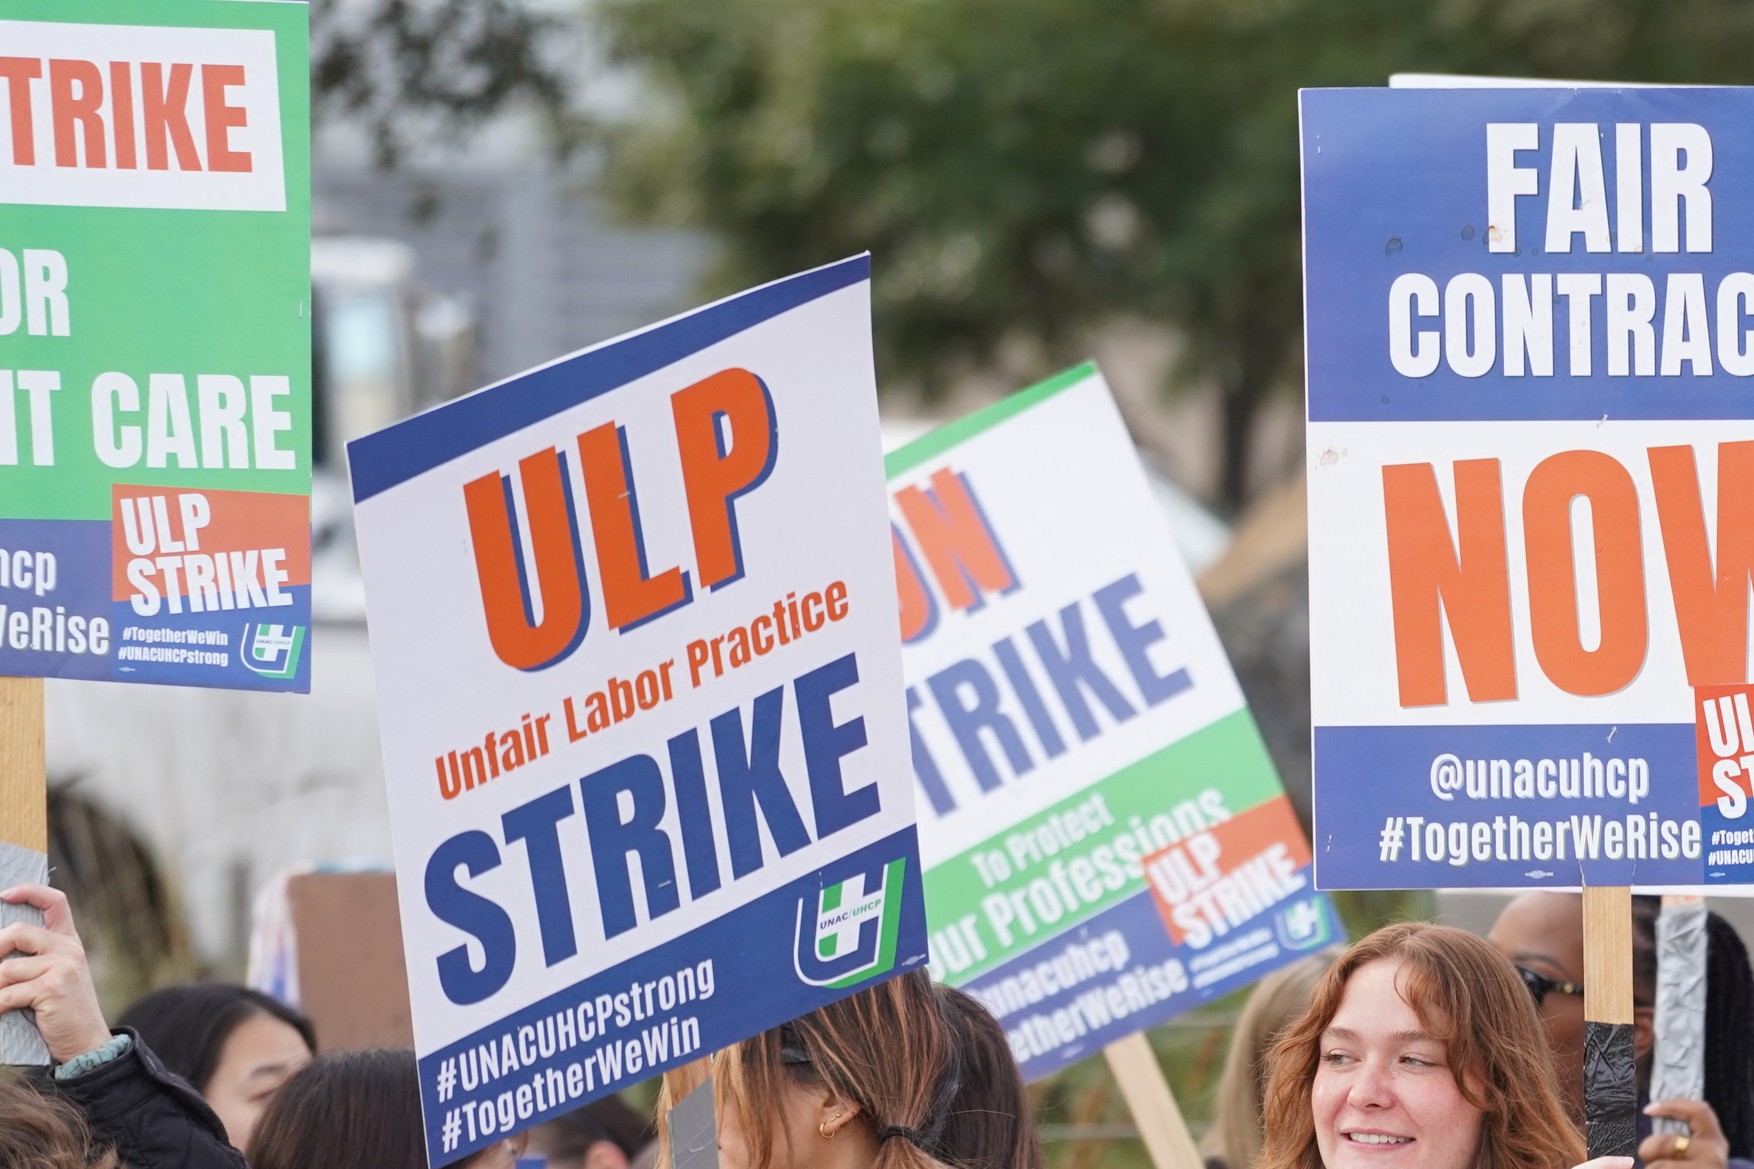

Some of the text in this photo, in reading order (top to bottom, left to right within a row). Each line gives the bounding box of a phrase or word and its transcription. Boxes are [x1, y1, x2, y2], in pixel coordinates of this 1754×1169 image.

[0, 57, 253, 173] TRIKE
[1485, 121, 1715, 255] FAIR
[91, 371, 297, 470] CARE
[119, 492, 212, 557] ULP
[462, 366, 778, 673] ULP
[0, 605, 110, 656] eRise
[126, 547, 294, 617] STRIKE
[118, 646, 229, 667] #UNACUHCPstrong
[122, 626, 229, 646] #TogetherWeWin
[436, 580, 849, 801] Unfair Labor Practice
[906, 572, 1195, 819] TRIKE
[1429, 752, 1650, 803] @unacuhcp
[425, 652, 882, 1005] STRIKE
[970, 792, 1117, 889] To Protect
[982, 788, 1234, 950] Professions
[1147, 831, 1223, 904] ULP
[1379, 812, 1702, 866] #TogetherWeRise
[820, 899, 882, 929] UNAC/UHCP
[1172, 843, 1308, 950] STRIKE
[970, 930, 1131, 1018] unacuhcp
[1012, 957, 1190, 1064] etherWeRise
[436, 958, 716, 1103] #UNACUHCPstrong
[441, 1016, 700, 1153] #TogetherWeWin
